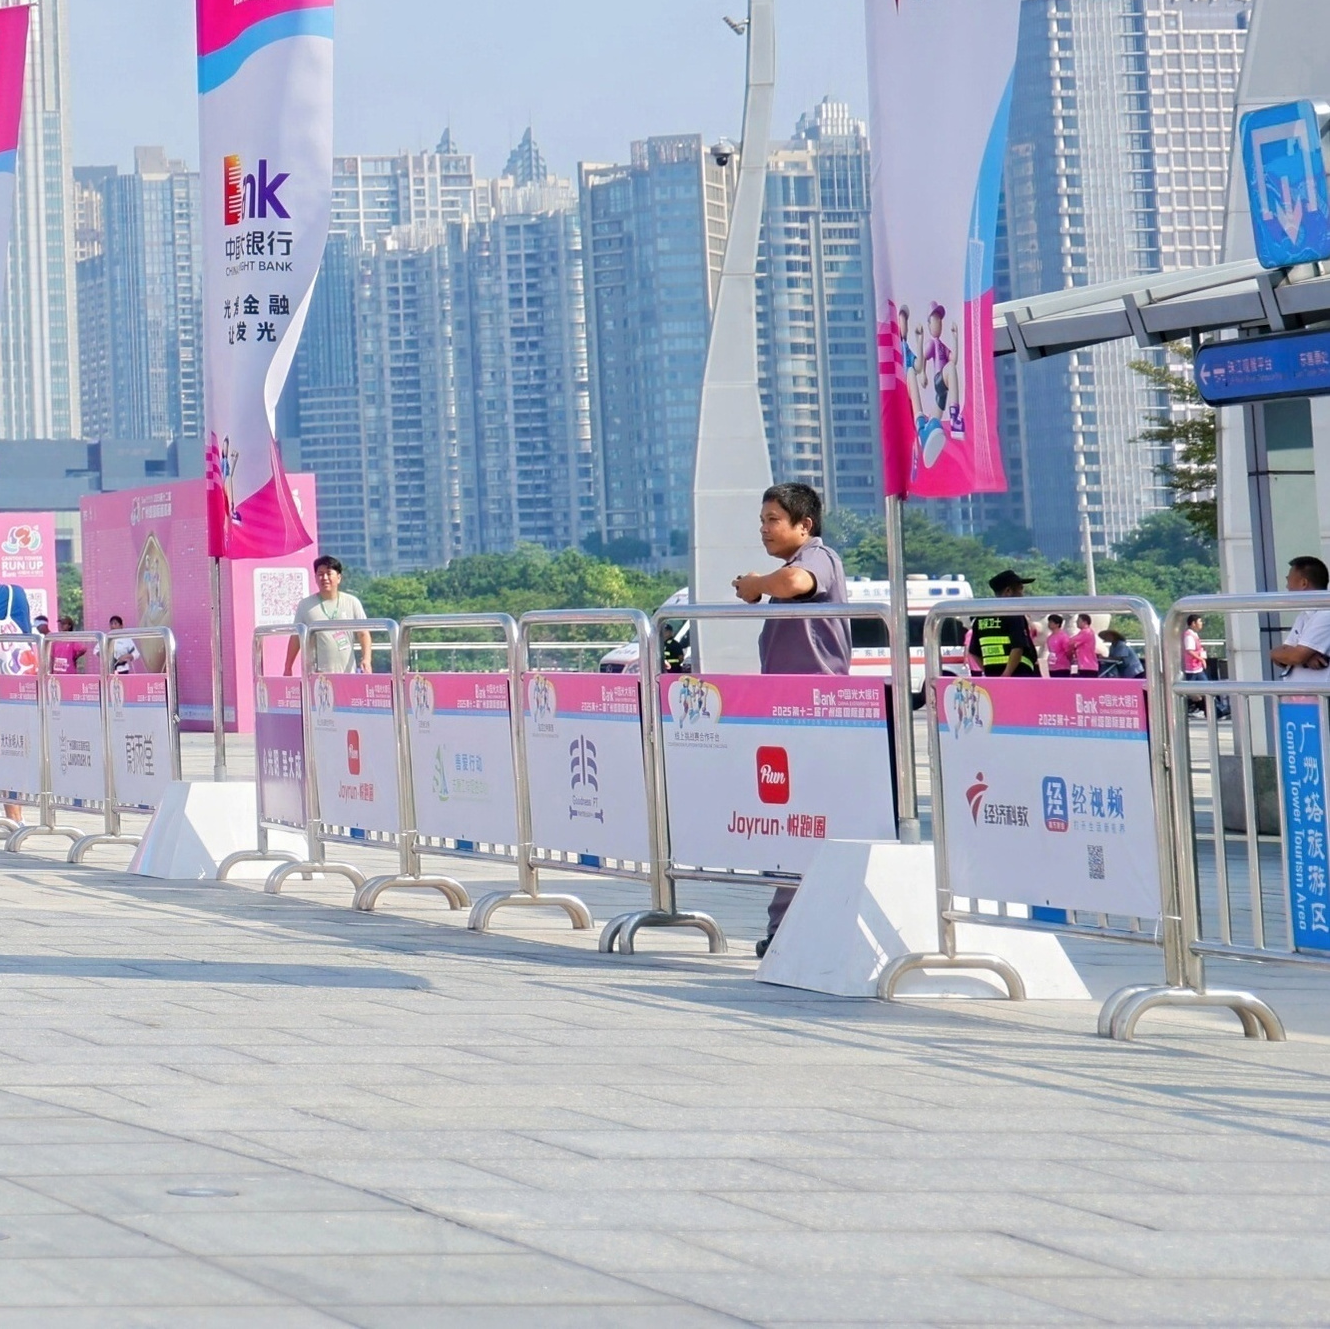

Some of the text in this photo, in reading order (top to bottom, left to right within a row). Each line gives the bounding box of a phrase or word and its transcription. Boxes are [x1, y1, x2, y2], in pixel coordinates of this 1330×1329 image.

[258, 261, 293, 272] BANK
[224, 293, 291, 319] 光金融
[228, 320, 277, 345] 让发光
[1, 561, 44, 571] RUN UP
[812, 688, 880, 707] Bank 中国光大银行
[1075, 693, 1139, 714] Bank 中国光大银行
[772, 706, 881, 719] 2025第十二届广州塔国际登高赛
[1038, 713, 1141, 730] 2025第十二届广州塔国际登高赛
[759, 764, 786, 786] Run
[1071, 783, 1125, 820] 经视频
[984, 803, 1030, 828] 经济科教
[1285, 721, 1307, 932] Canton Tower Tourism Area
[1299, 721, 1329, 934] 广州塔旅游区
